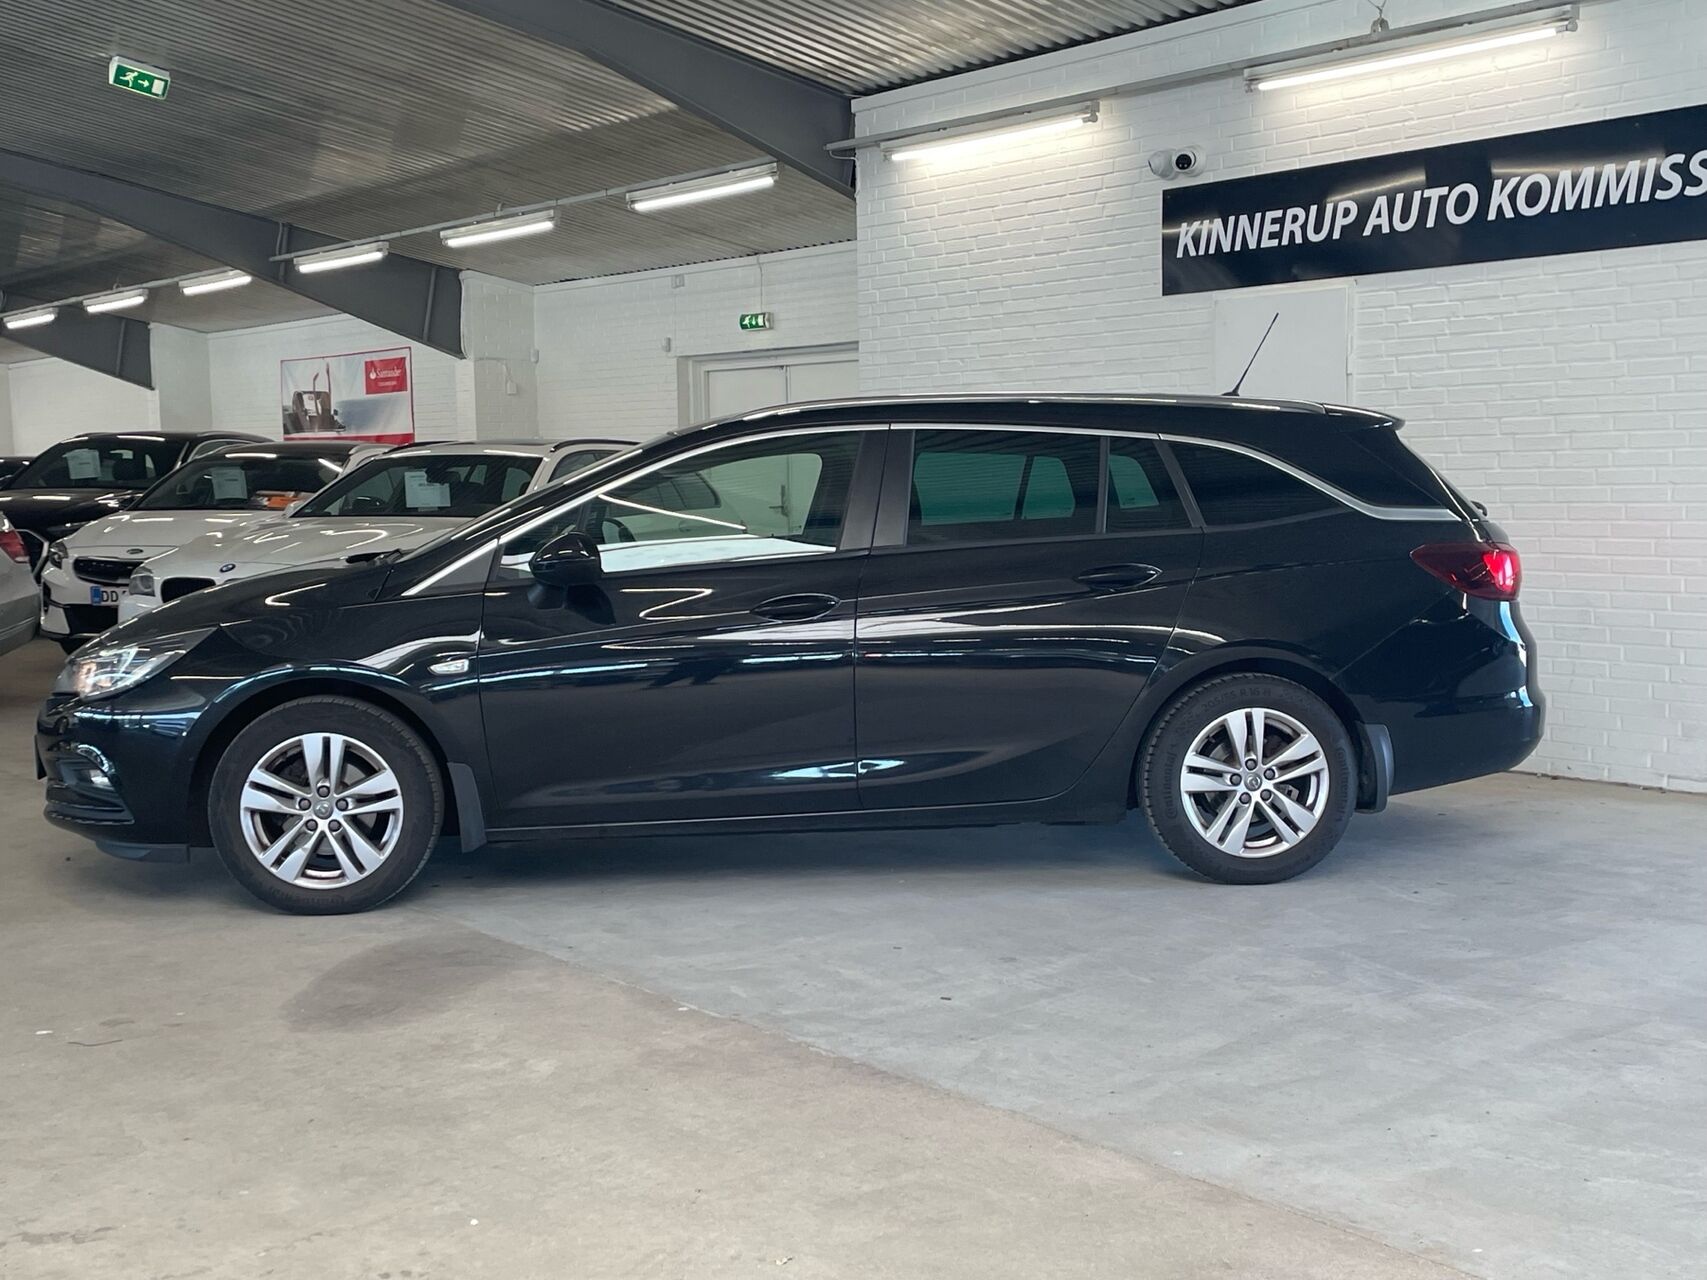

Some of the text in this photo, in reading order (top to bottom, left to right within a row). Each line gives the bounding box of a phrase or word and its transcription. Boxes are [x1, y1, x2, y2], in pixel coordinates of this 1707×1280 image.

[1176, 150, 1707, 258] KINNERUP AUTO KOMMISS
